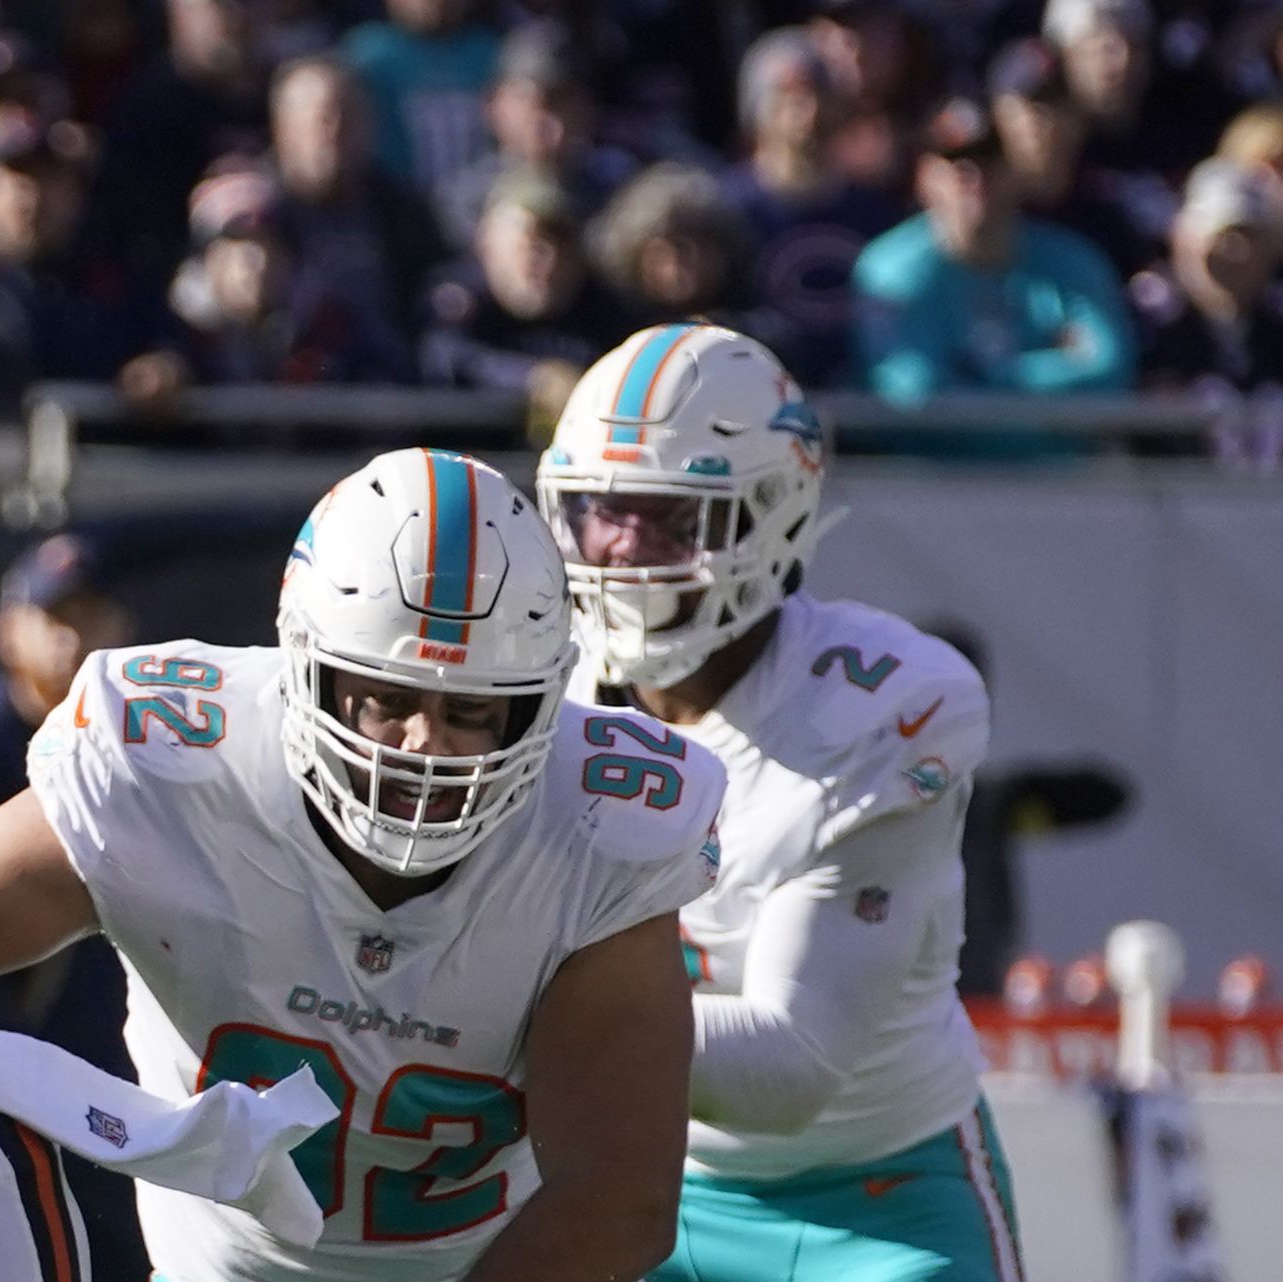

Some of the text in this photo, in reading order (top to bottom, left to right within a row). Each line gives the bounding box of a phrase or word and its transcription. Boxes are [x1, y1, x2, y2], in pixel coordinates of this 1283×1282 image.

[122, 654, 226, 749] 92
[811, 643, 902, 693] 2
[582, 715, 687, 811] 92
[287, 985, 461, 1048] Dolphins
